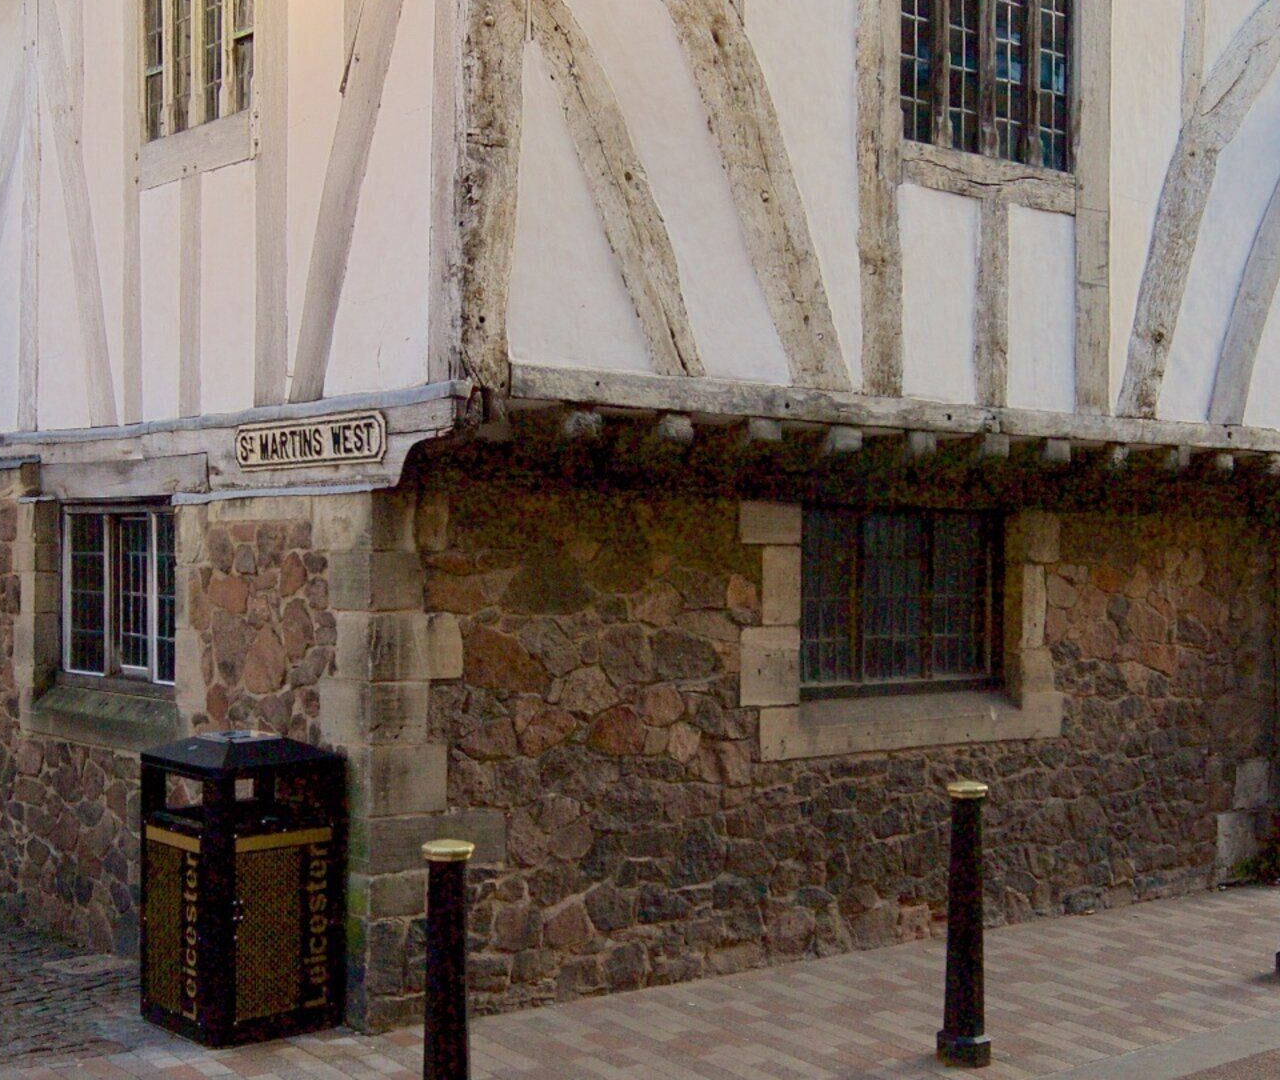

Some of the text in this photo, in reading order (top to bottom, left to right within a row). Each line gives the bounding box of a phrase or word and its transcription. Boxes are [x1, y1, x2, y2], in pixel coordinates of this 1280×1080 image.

[260, 428, 323, 460] MARTINS
[331, 422, 374, 455] WEST
[183, 853, 197, 1021] Leicester
[304, 844, 328, 1009] Leicester
